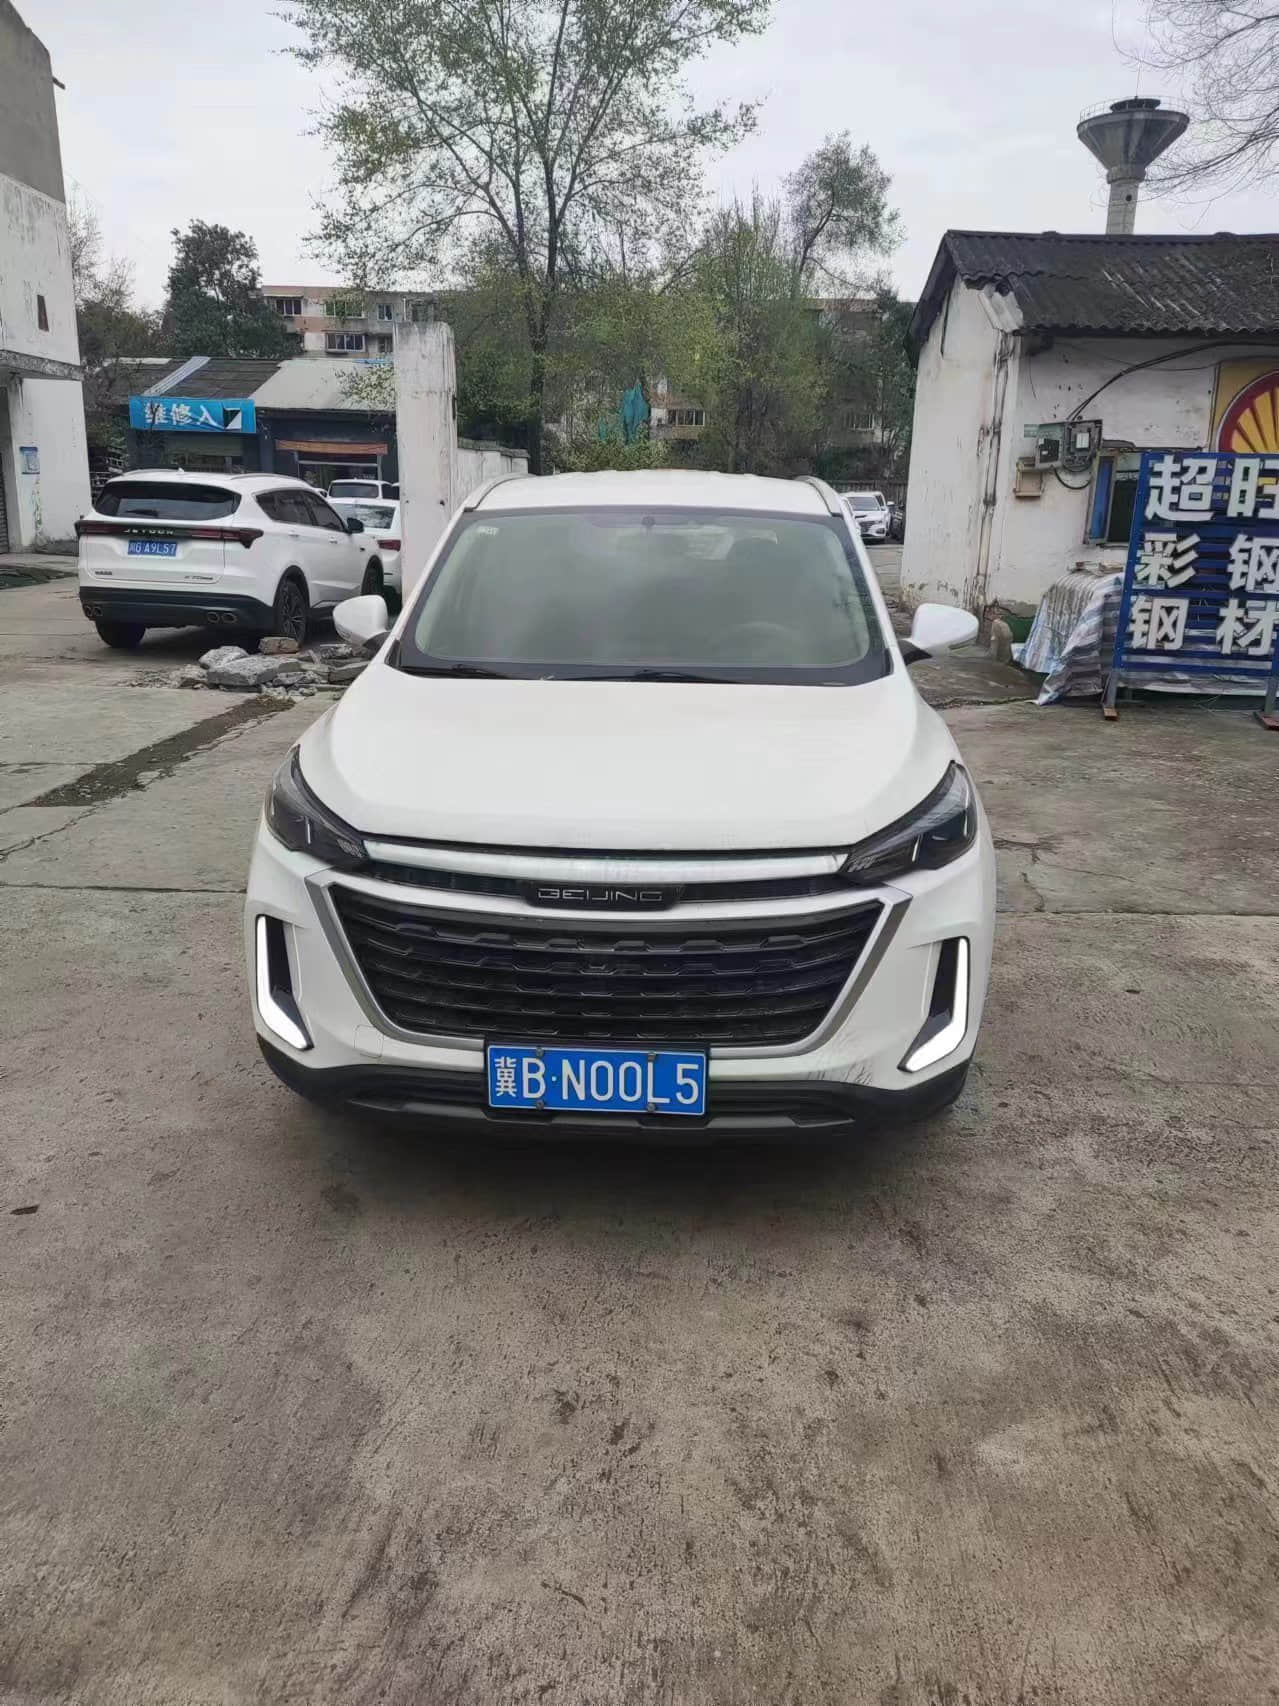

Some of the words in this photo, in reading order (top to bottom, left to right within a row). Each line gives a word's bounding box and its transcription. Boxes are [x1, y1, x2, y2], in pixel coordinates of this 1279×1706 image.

[1130, 595, 1279, 656] 钢材
[538, 887, 662, 903] BEIJING
[495, 1056, 699, 1105] 冀B·N00L5
